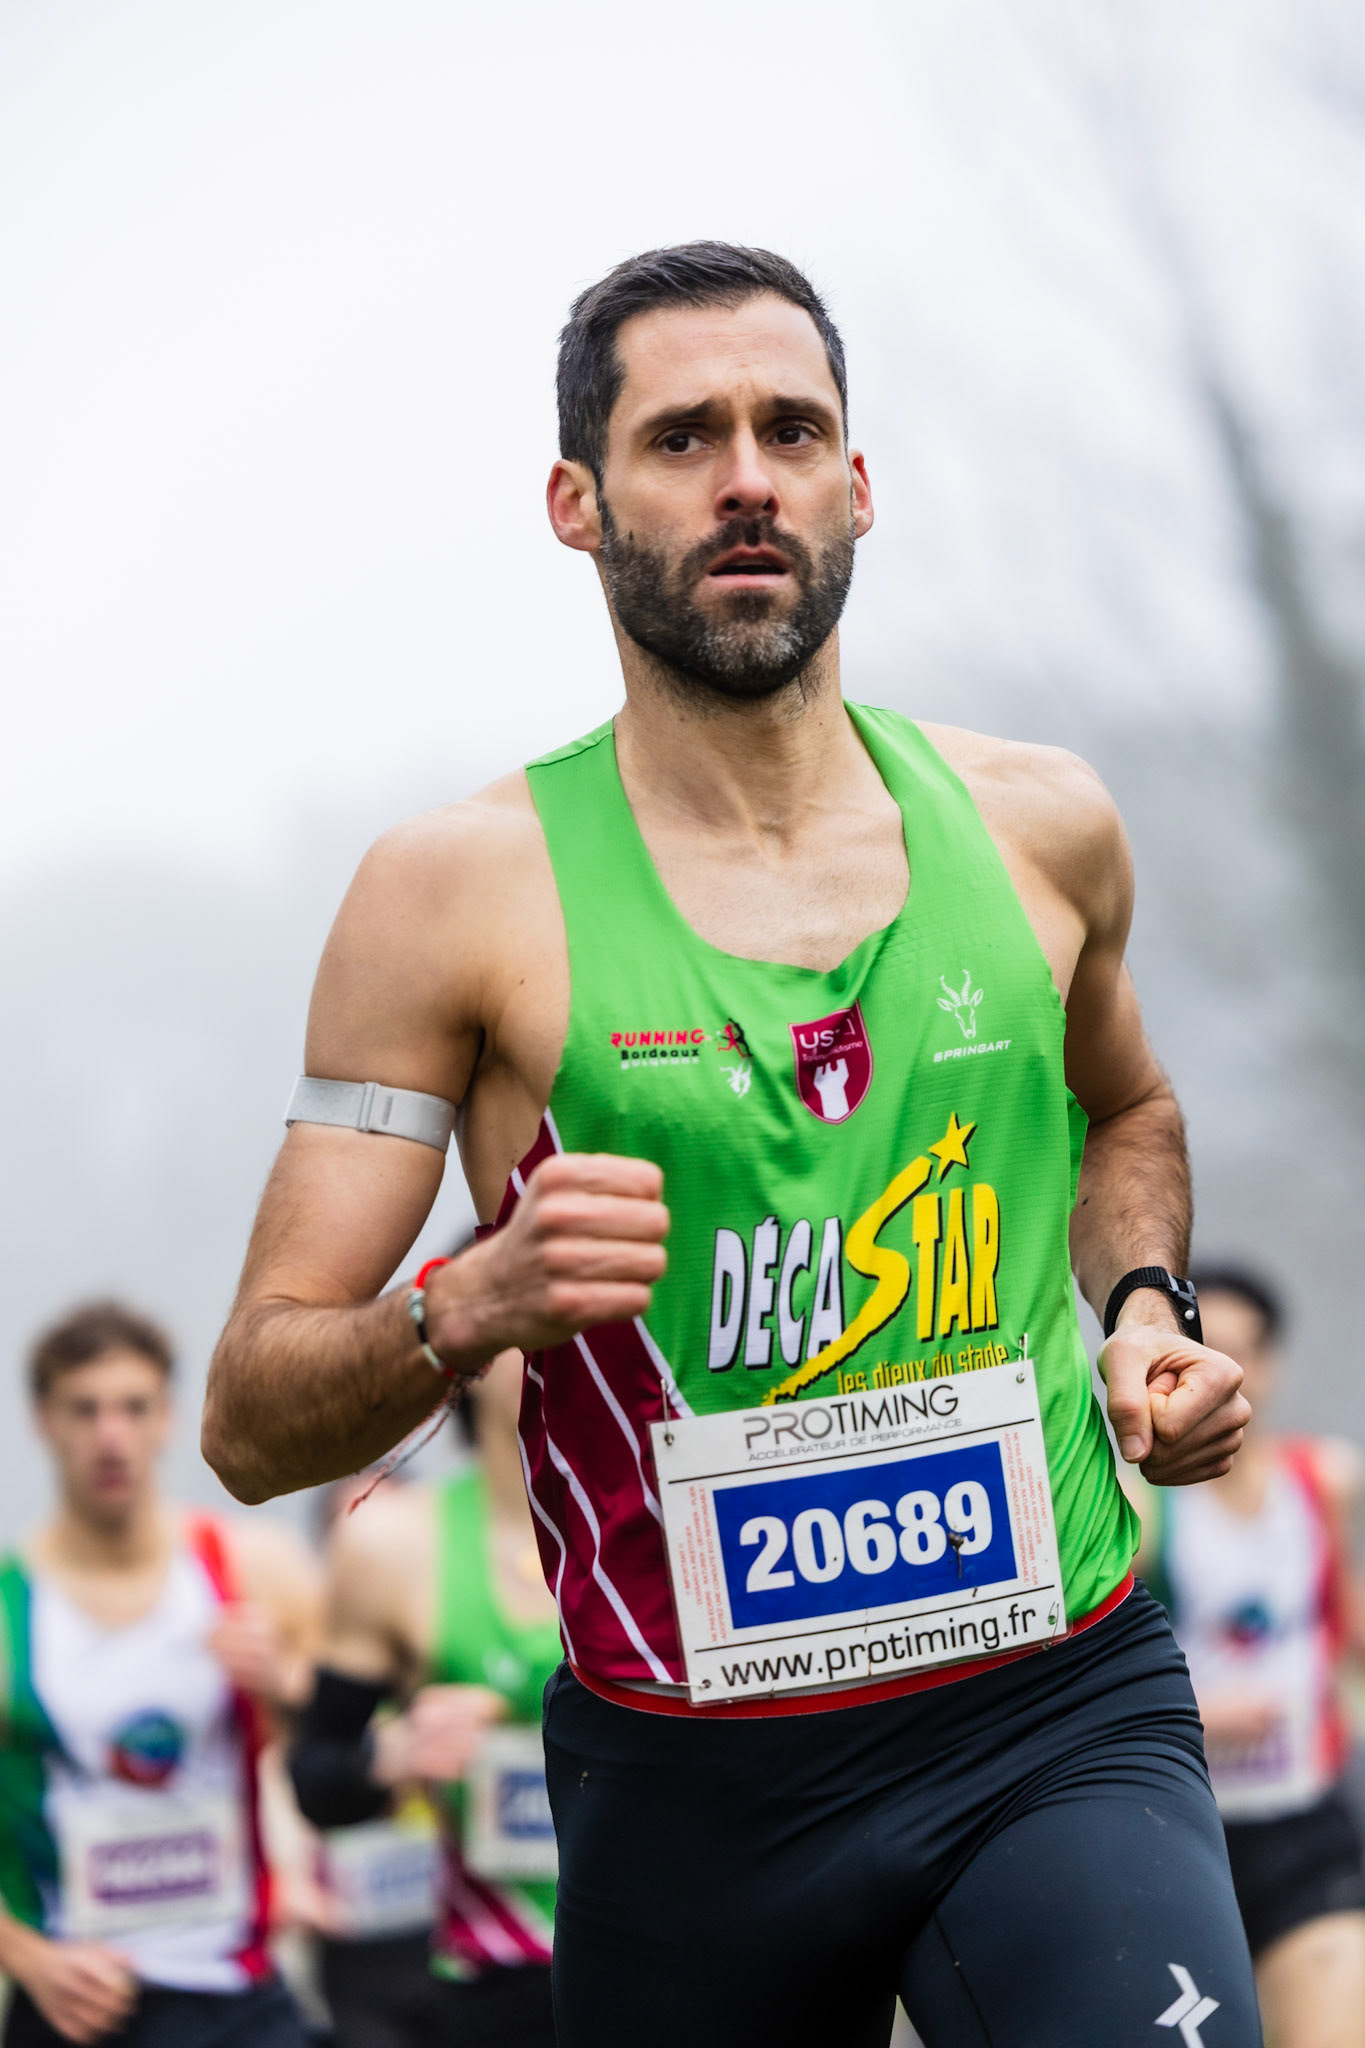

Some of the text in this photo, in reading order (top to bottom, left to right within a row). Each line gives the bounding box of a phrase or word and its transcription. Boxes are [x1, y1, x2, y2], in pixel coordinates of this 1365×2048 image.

[610, 1029, 703, 1048] RUNNING
[621, 1048, 700, 1060] Bordeaux
[933, 1040, 1012, 1063] SPRINGART
[837, 1340, 1009, 1395] les dieux du stade
[743, 1384, 959, 1449] PROTIMING
[739, 1480, 993, 1593] 20689
[721, 1604, 1036, 1687] www.protiming.fr
